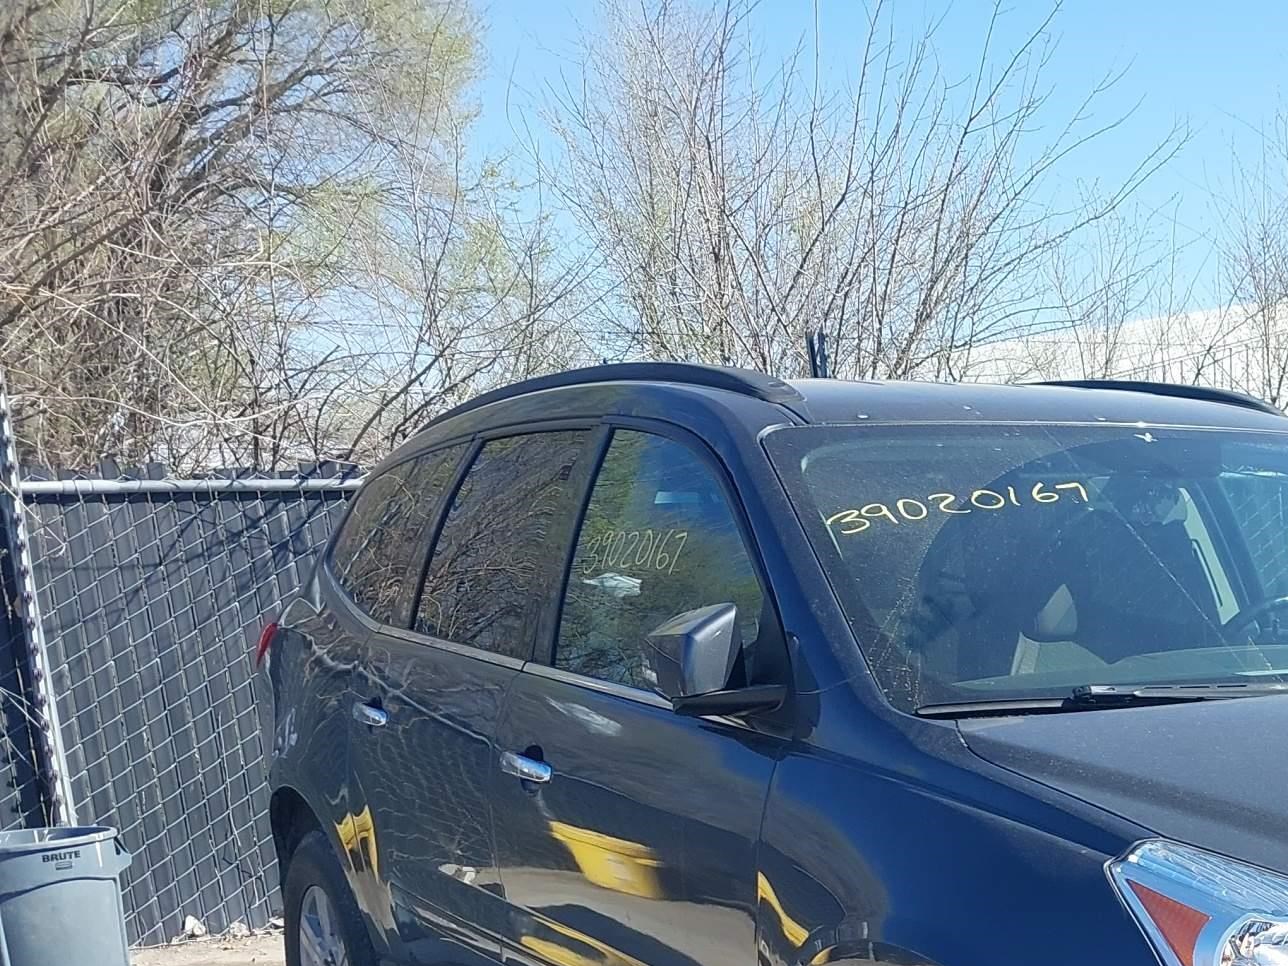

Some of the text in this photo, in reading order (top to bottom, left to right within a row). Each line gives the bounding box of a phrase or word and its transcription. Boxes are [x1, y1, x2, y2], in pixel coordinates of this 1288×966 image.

[826, 482, 1089, 534] 39020167
[582, 528, 688, 575] 39020167
[41, 850, 81, 863] BRUTE
